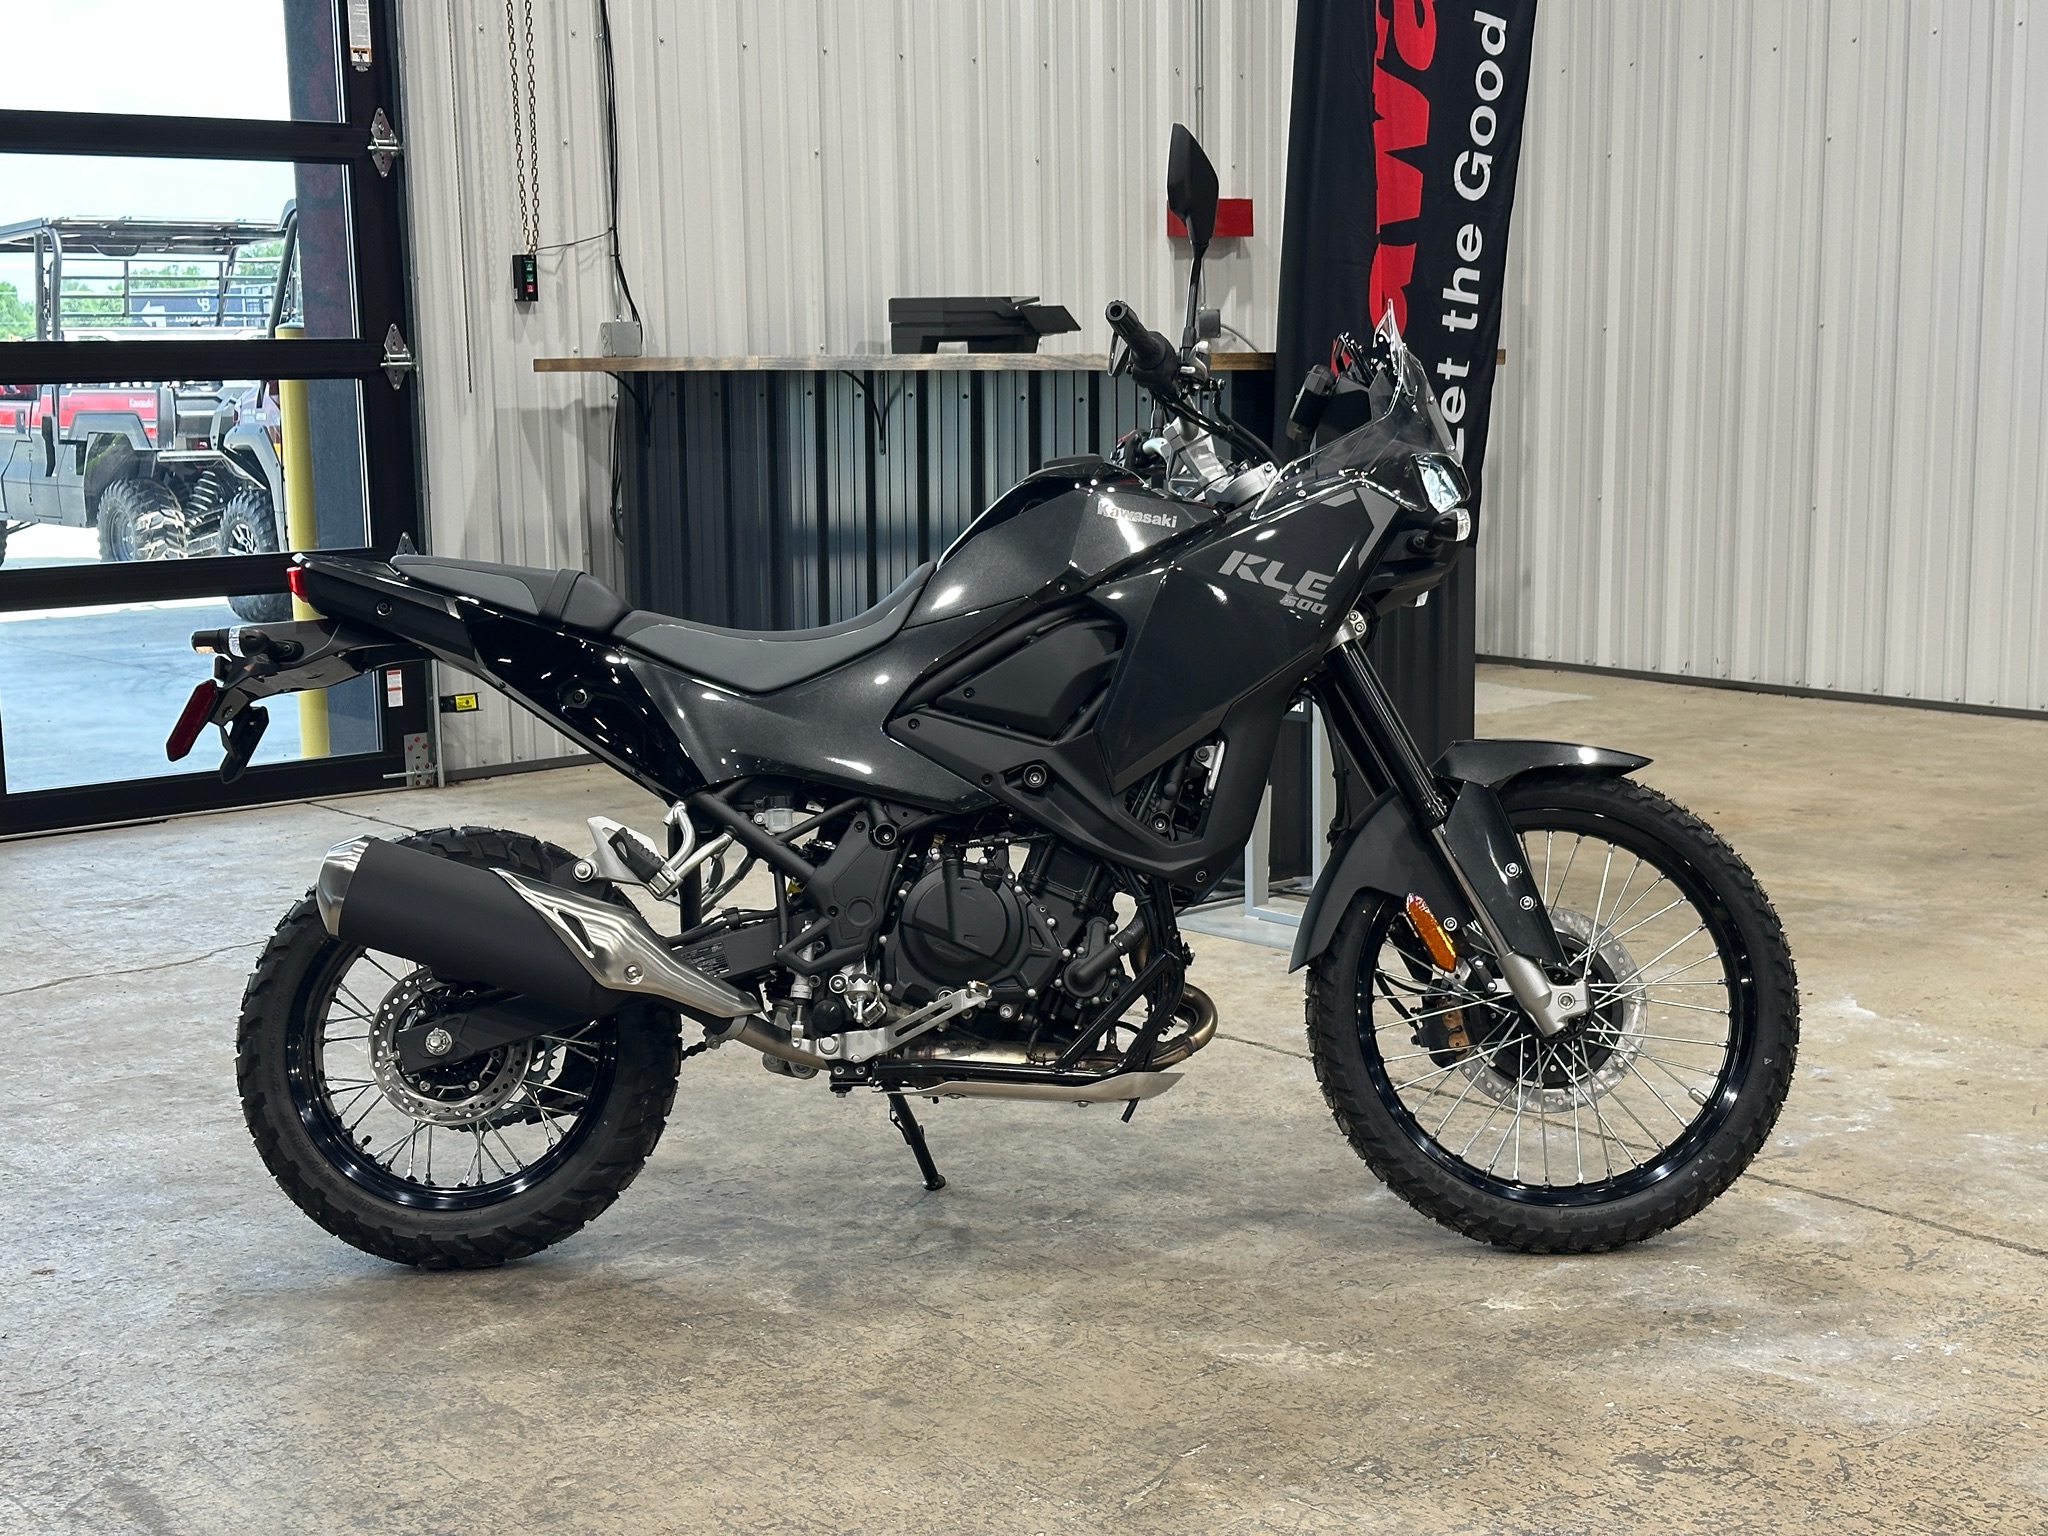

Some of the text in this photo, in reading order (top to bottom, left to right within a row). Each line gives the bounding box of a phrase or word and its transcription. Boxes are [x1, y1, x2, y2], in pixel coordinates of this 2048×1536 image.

[1453, 10, 1507, 201] Good
[1442, 223, 1483, 332] the
[1097, 500, 1178, 529] Kawasaki
[1218, 550, 1335, 600] KLE
